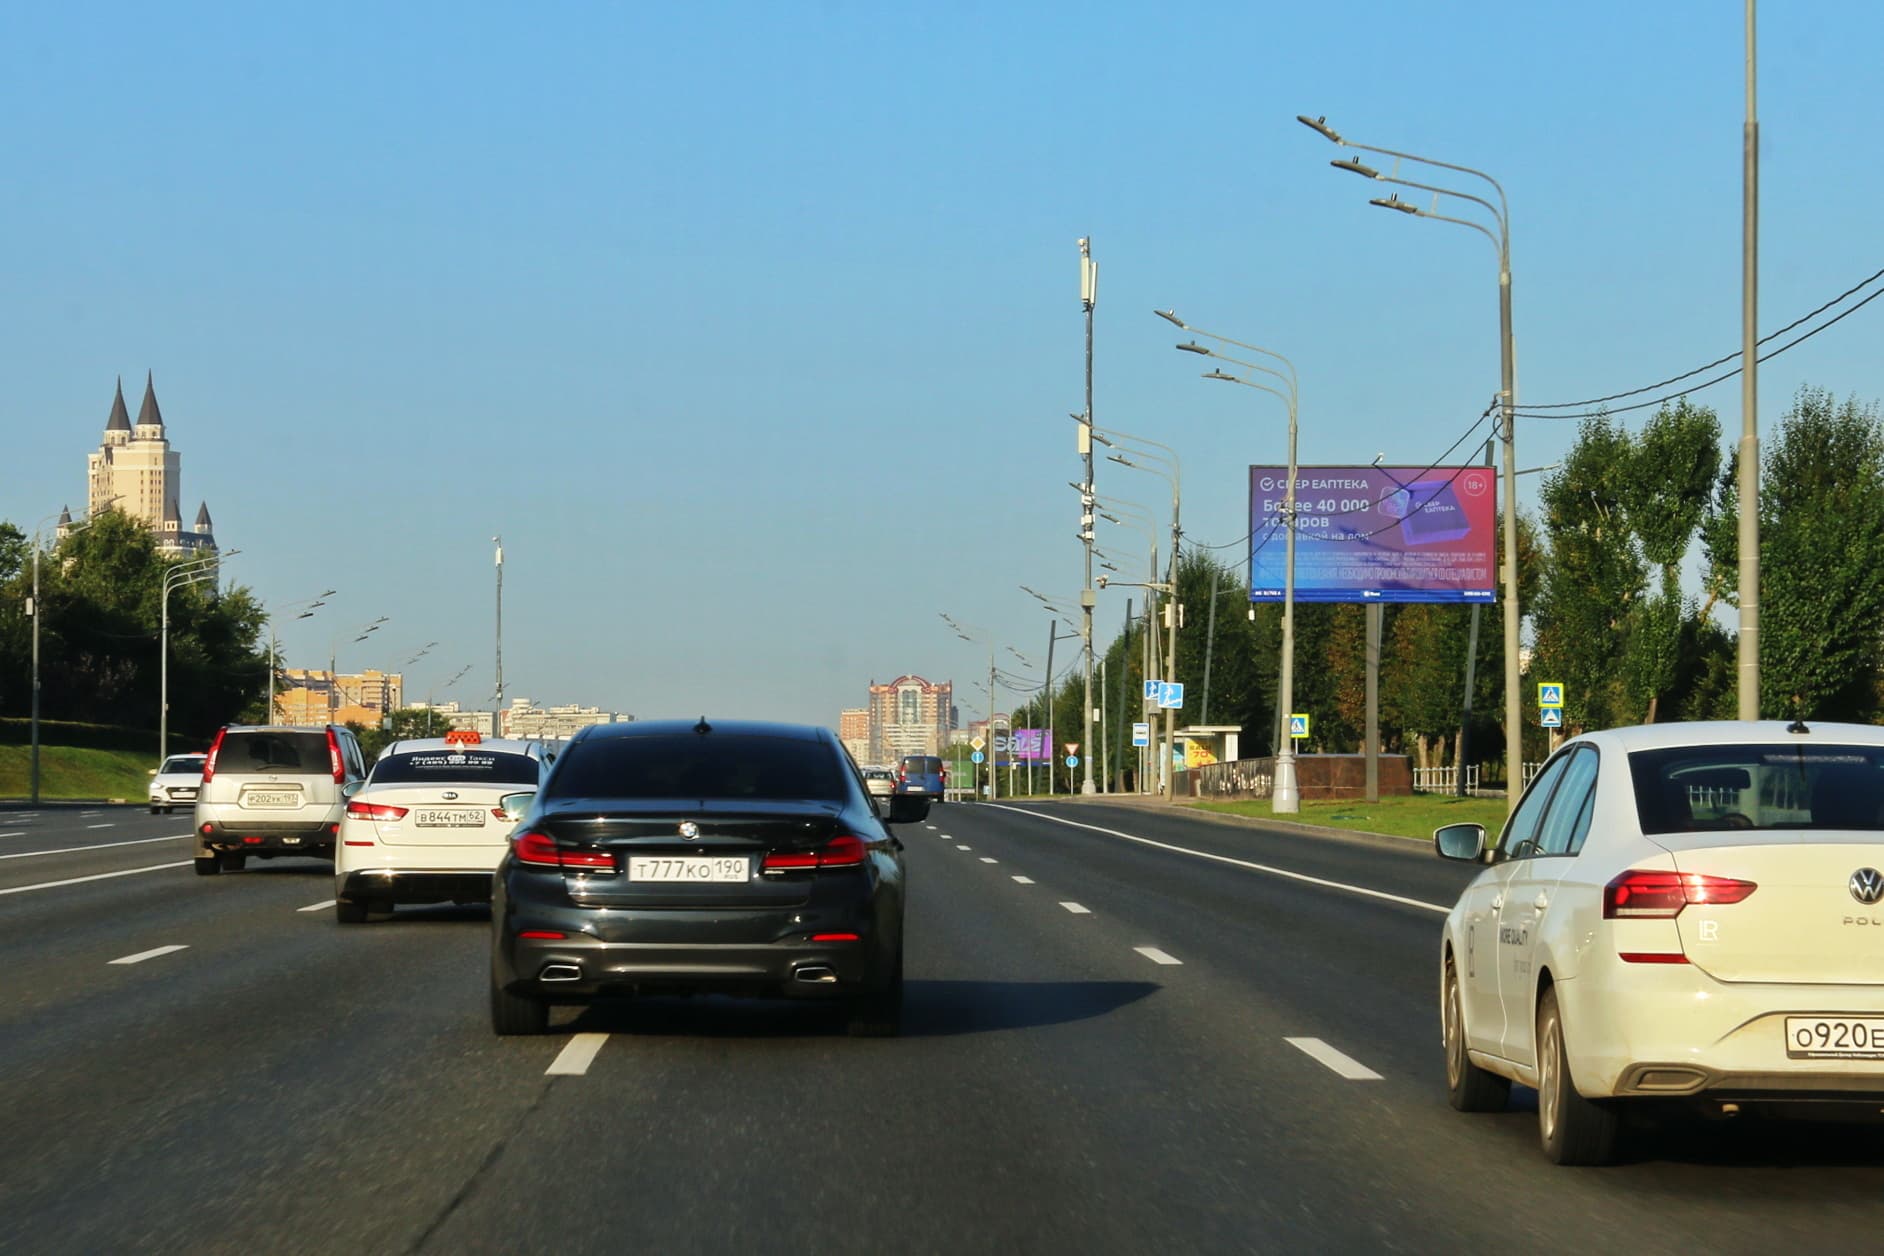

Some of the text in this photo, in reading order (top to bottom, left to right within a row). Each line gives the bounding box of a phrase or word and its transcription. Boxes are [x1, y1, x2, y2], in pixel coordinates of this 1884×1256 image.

[1312, 480, 1369, 489] ЕАПТЕКА
[1467, 481, 1484, 489] 18+
[1263, 499, 1369, 512] Боее 40 000
[469, 811, 480, 820] 62
[715, 860, 742, 873] 190
